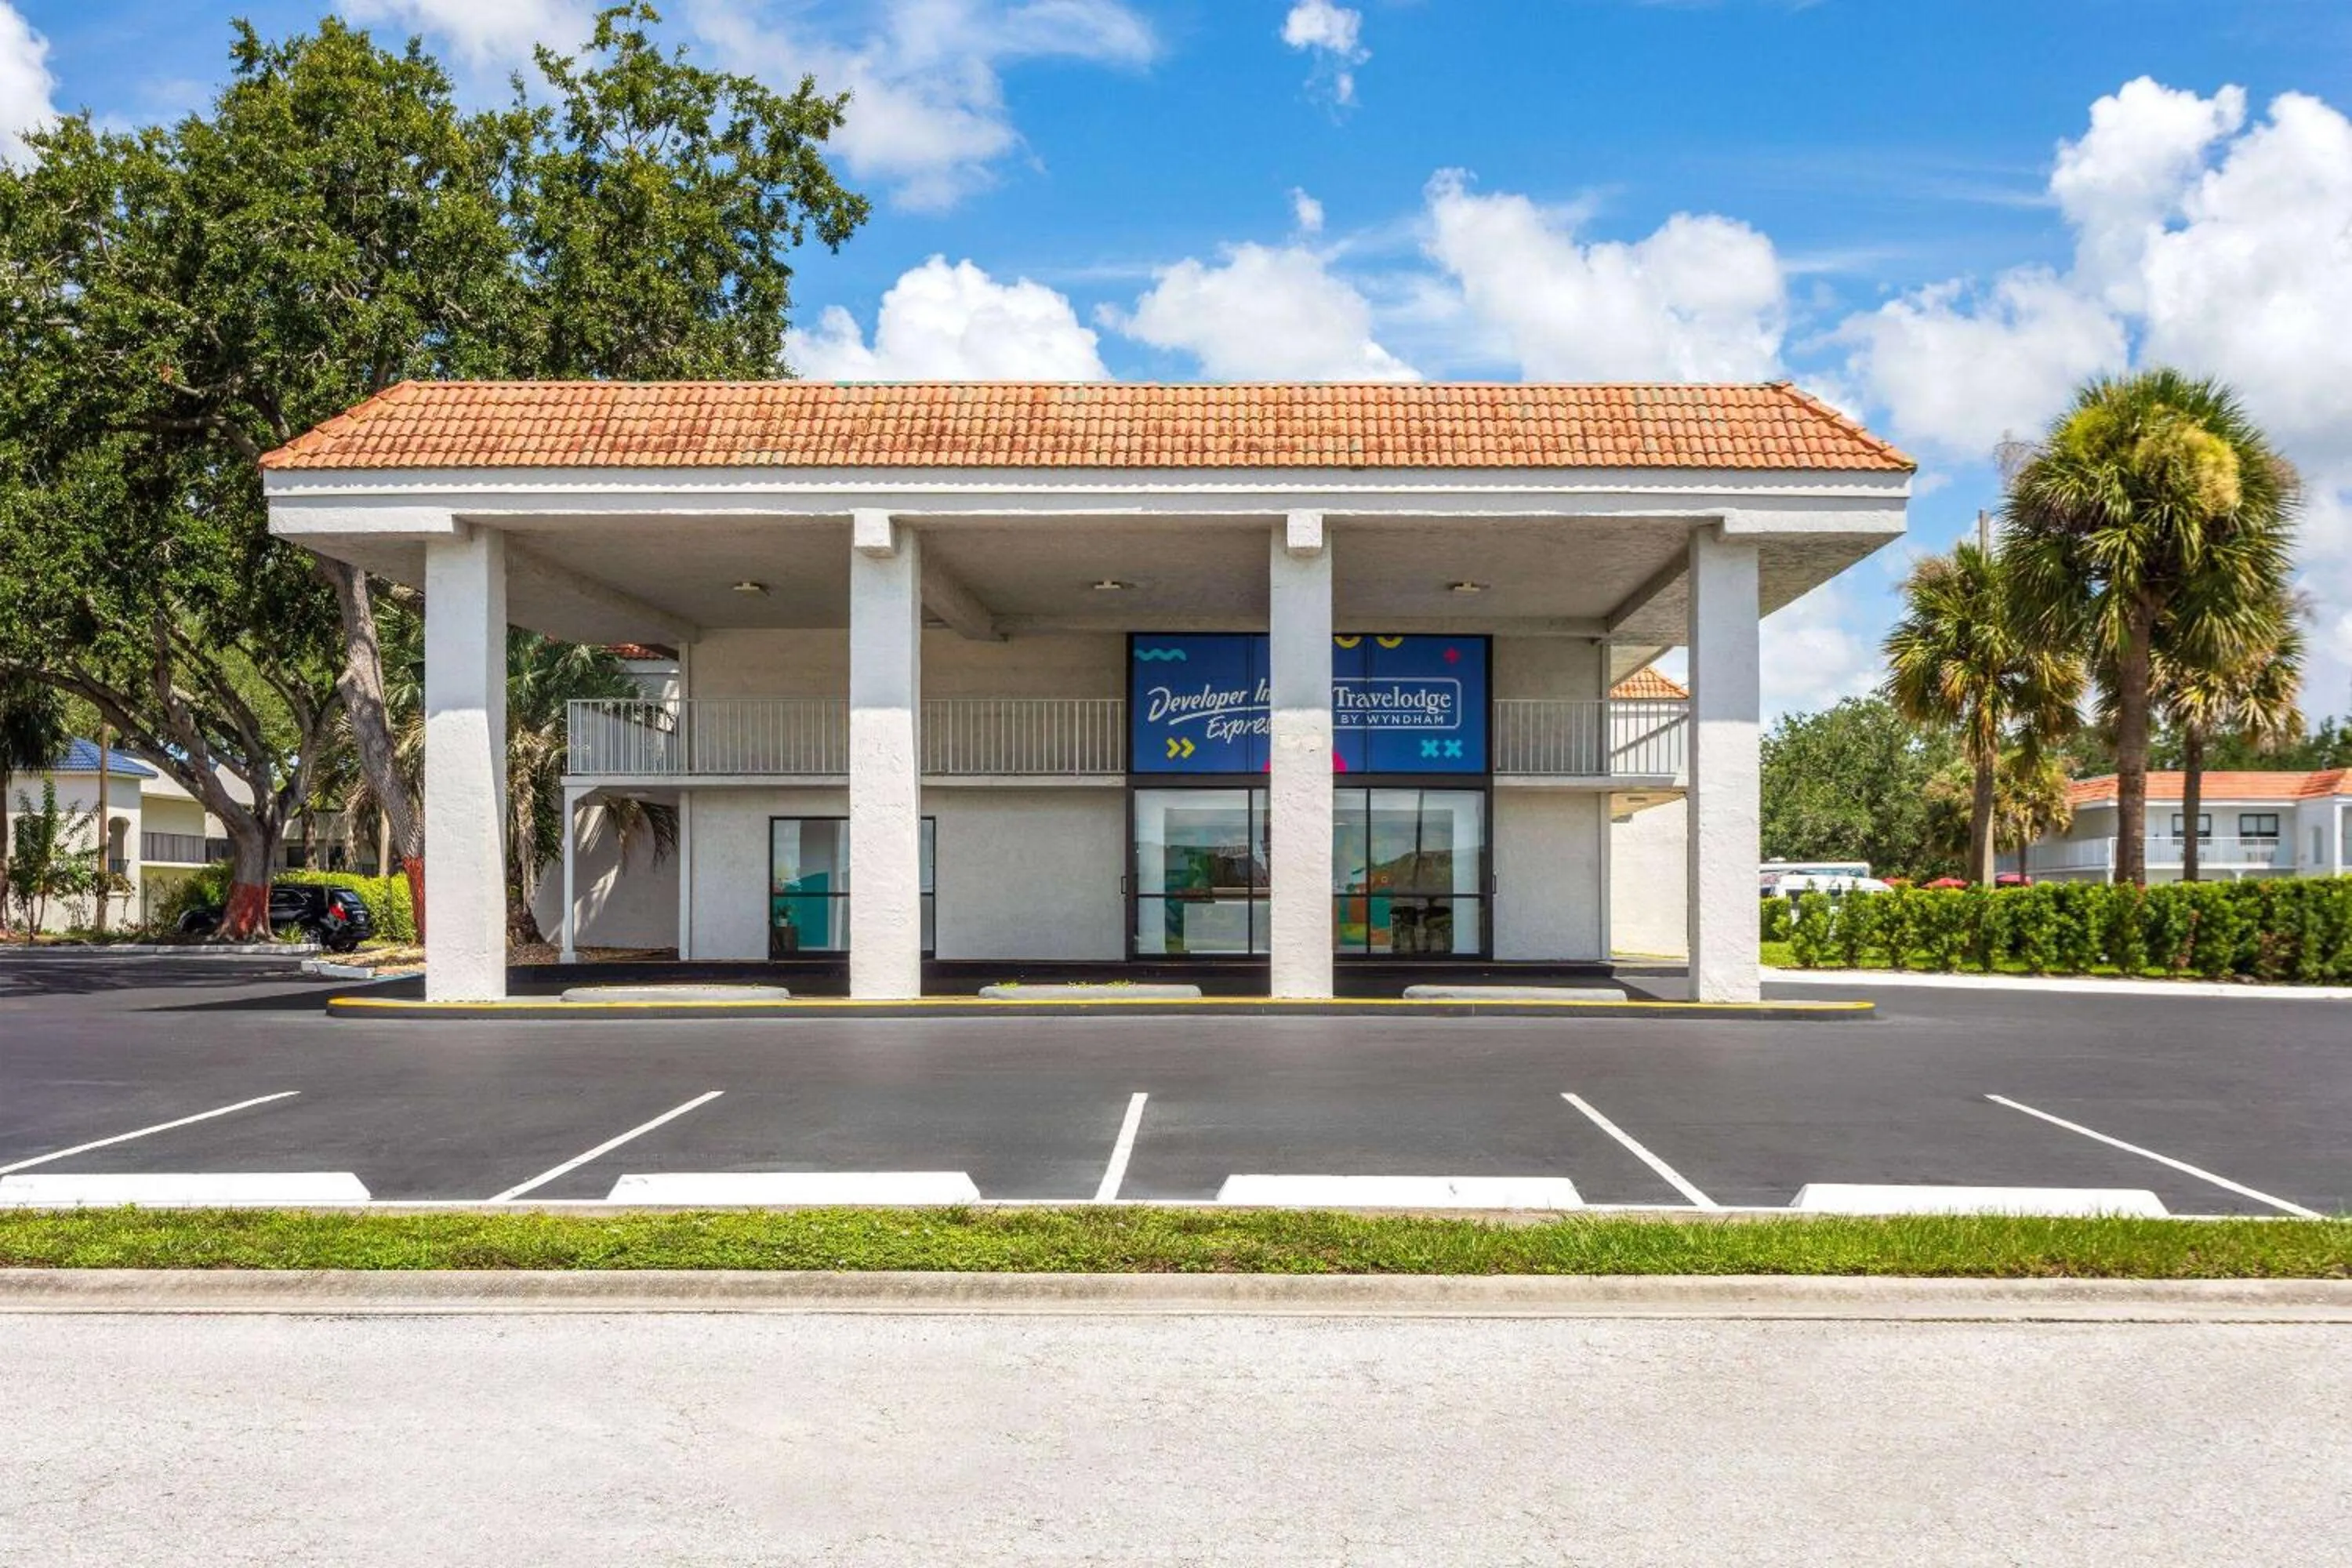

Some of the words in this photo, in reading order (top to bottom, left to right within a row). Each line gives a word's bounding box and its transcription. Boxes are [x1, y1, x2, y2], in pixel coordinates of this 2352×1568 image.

[1147, 684, 1249, 722] Developer
[1255, 677, 1270, 702] In
[1332, 686, 1451, 714] Travelodge
[1206, 714, 1271, 744] Expres
[1341, 714, 1359, 724] BY
[1367, 714, 1444, 724] WYNDHAM
